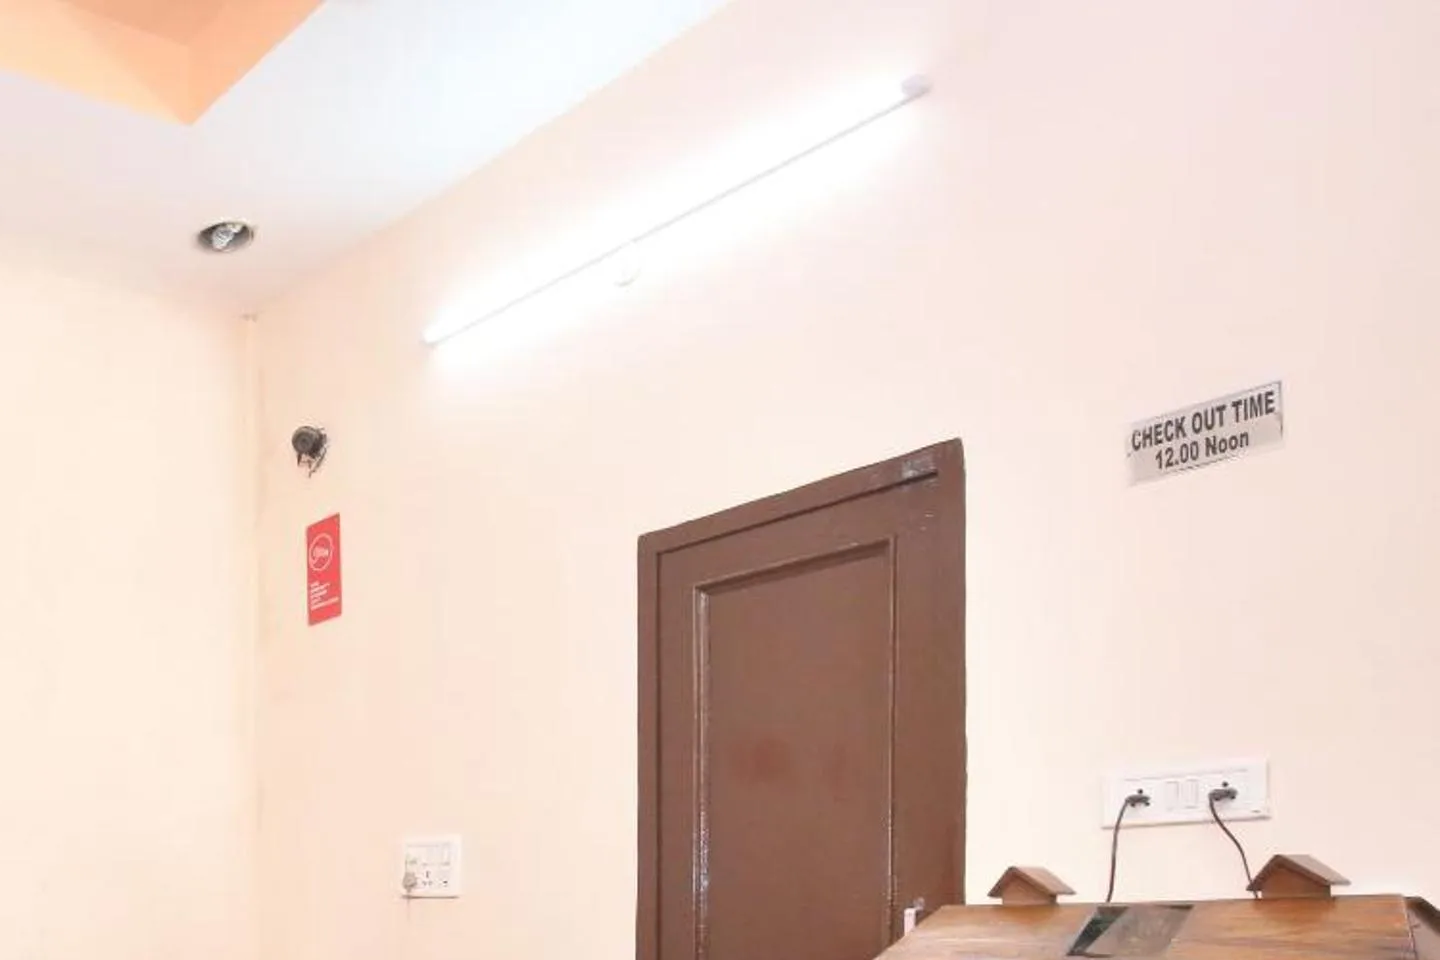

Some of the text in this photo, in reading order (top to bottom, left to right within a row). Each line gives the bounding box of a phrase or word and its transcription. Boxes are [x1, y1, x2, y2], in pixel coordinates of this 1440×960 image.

[1131, 391, 1276, 450] CHECK OUT TIME
[1155, 432, 1249, 469] 12.00 Noon
